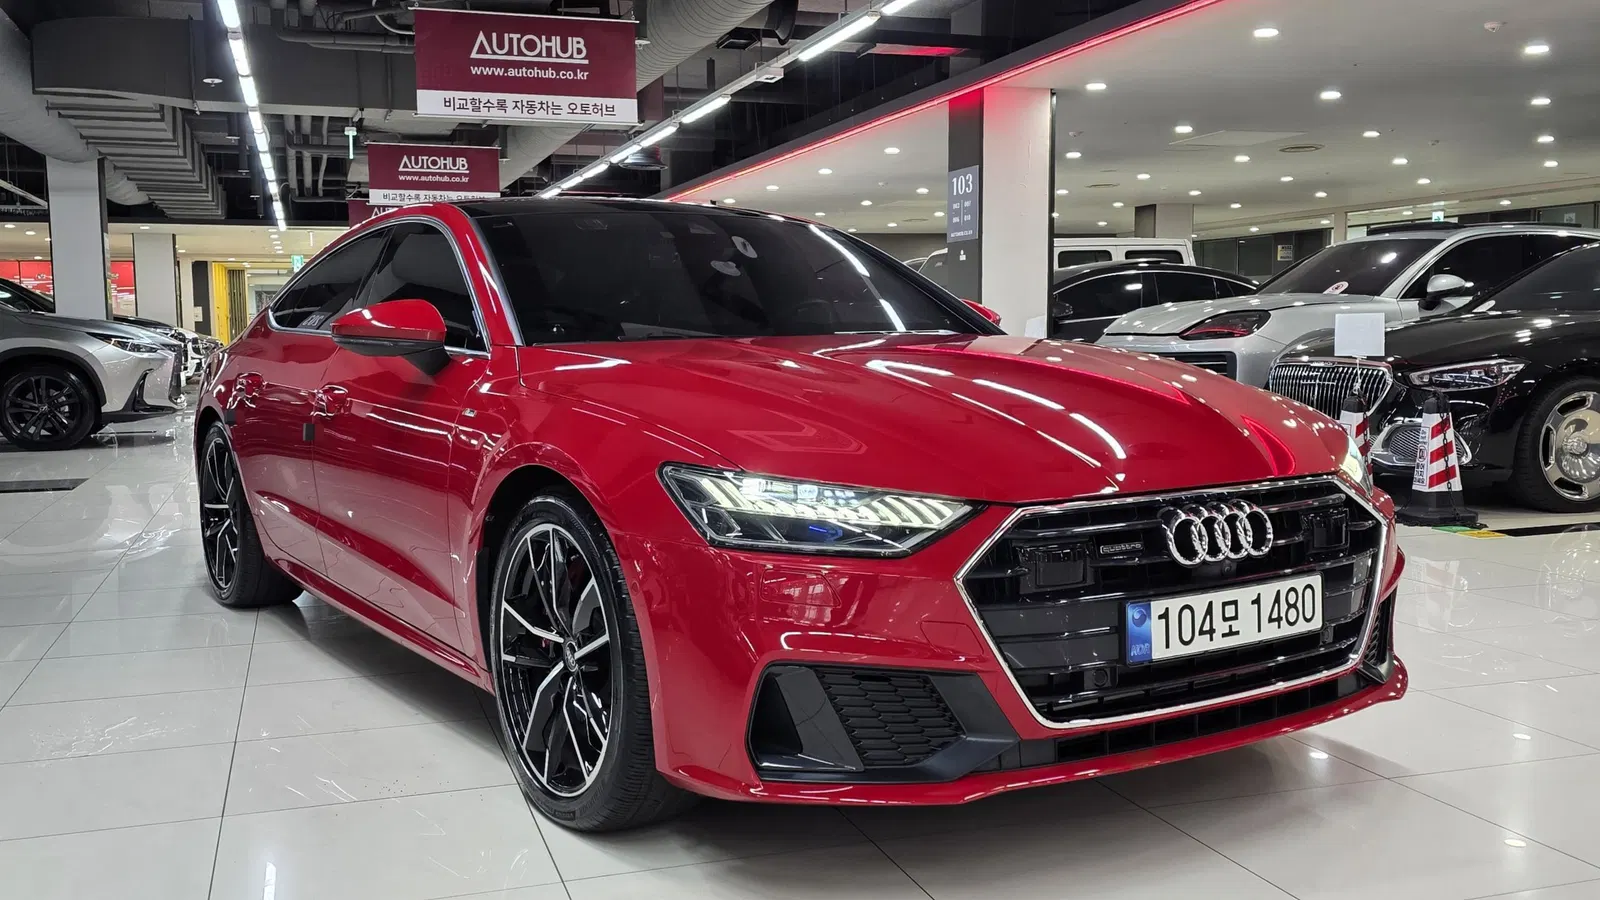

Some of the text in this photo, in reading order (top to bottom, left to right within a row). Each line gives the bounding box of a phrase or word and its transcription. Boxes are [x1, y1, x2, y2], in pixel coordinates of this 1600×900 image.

[470, 30, 589, 63] AUTOHUB
[470, 64, 589, 81] www.autohub.co.kr
[443, 96, 616, 117] 비교할수록 자동차는 오토허브
[398, 154, 470, 173] AUTOHUB
[398, 174, 469, 183] www.autohub.co.kr
[952, 173, 973, 196] 103
[1103, 543, 1142, 553] quattro
[1157, 583, 1316, 649] 104모 1480
